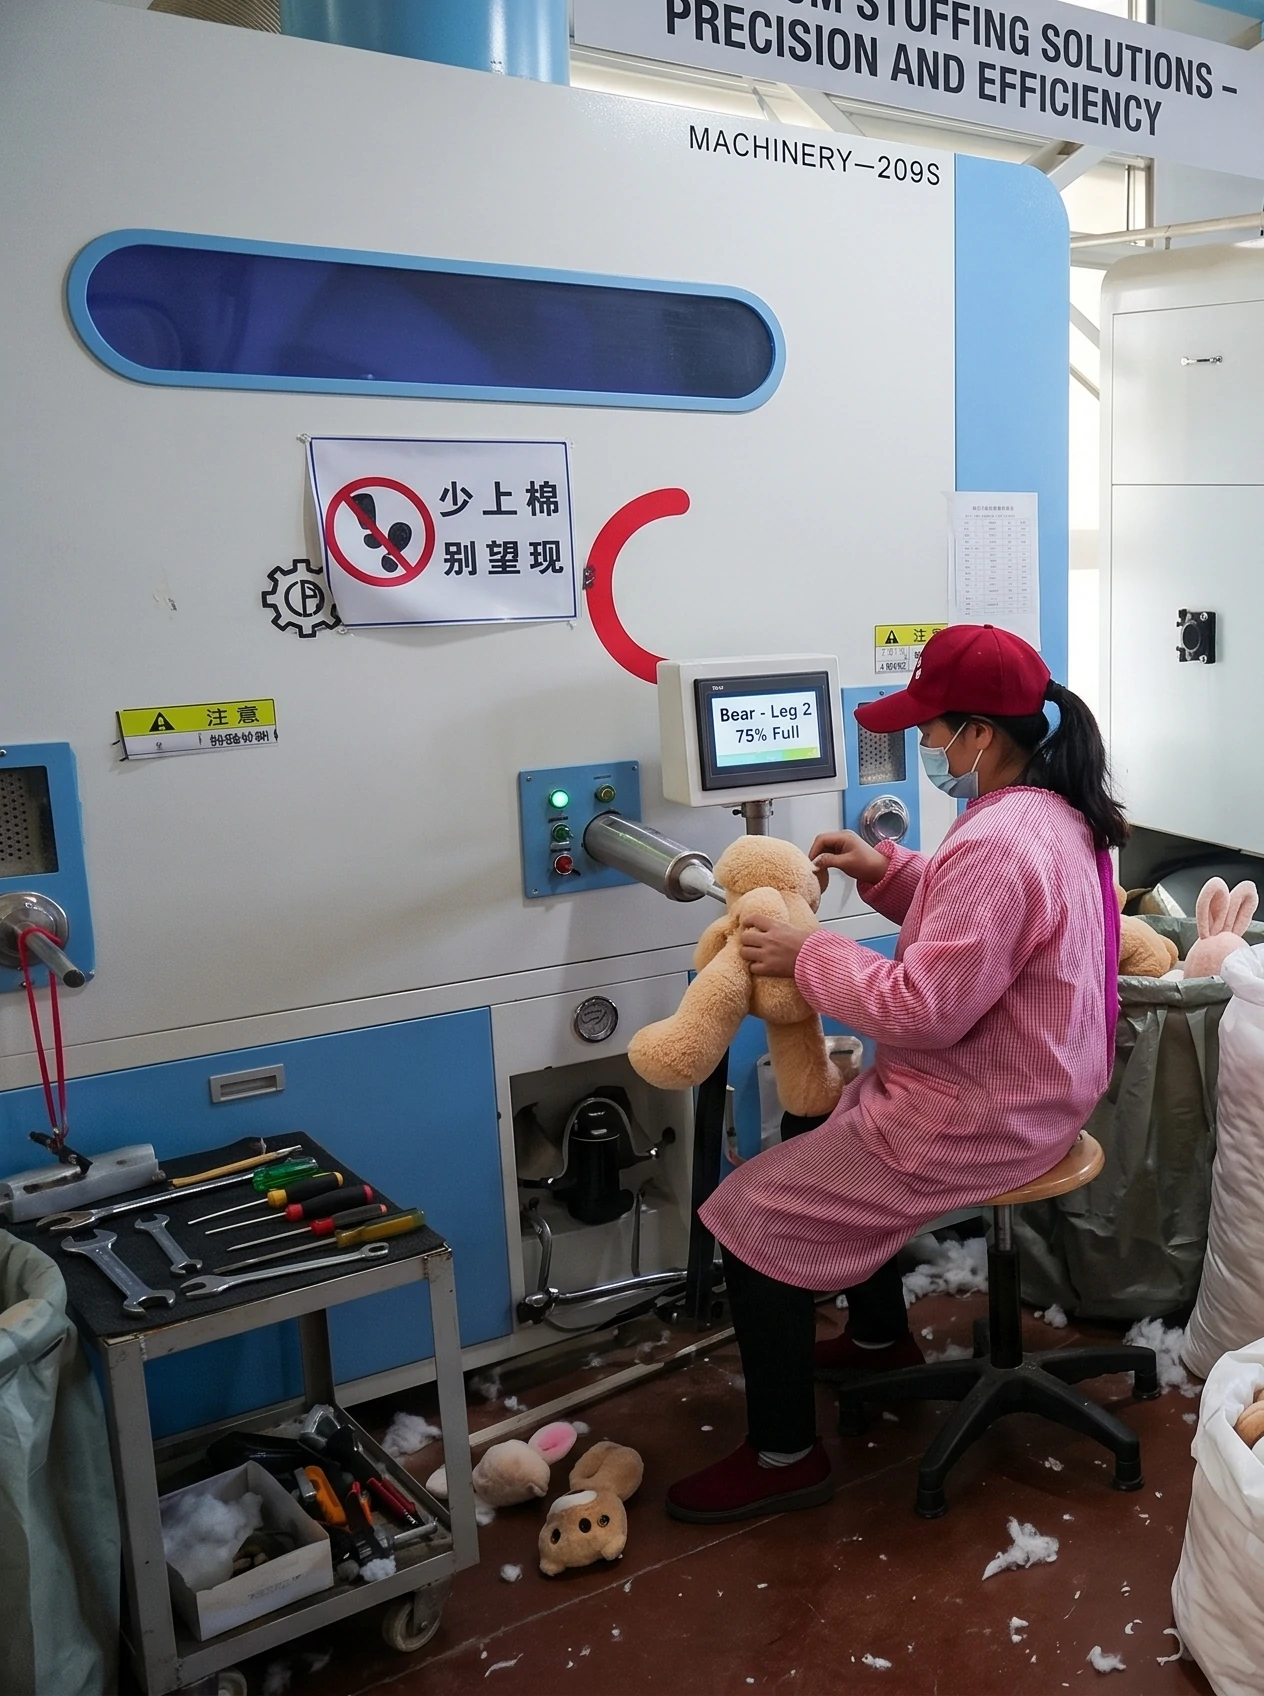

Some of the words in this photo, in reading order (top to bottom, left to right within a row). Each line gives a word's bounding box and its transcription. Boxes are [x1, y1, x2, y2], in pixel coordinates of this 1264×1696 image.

[666, 0, 878, 77] PRECISION
[890, 43, 965, 94] AND
[978, 61, 1162, 136] EFFICIENCY
[1041, 23, 1213, 99] SOLUTIONS
[439, 480, 560, 517] 少上棉
[206, 705, 260, 727] 注意
[720, 708, 755, 722] Bear
[771, 704, 798, 720] Leg
[802, 702, 812, 716] 2
[736, 728, 767, 743] 75%
[773, 725, 799, 740] Full
